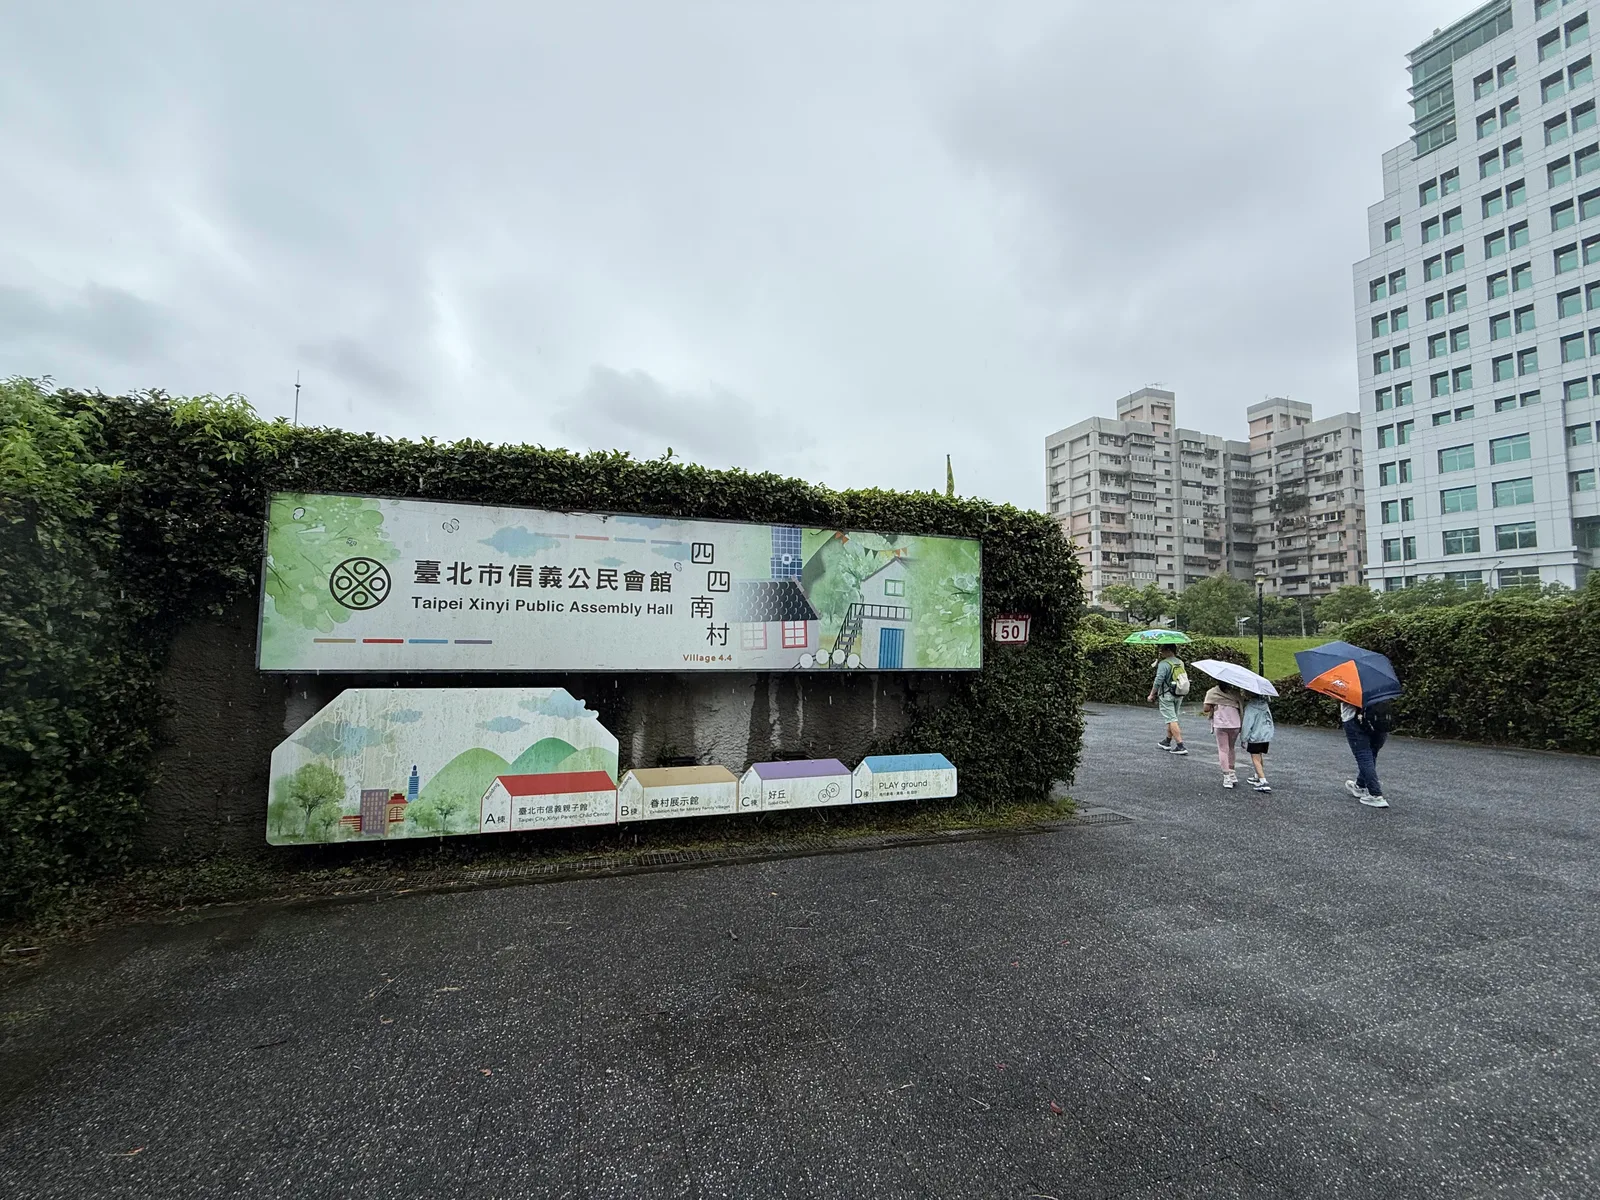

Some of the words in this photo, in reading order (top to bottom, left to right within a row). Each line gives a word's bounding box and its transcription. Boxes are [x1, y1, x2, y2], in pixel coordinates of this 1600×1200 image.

[414, 559, 672, 593] 臺北市信義公民會館
[690, 542, 730, 646] 四四南村
[411, 596, 463, 612] Taipei
[469, 598, 510, 614] Xinyi
[515, 599, 564, 613] Public
[570, 601, 642, 617] Assembly
[647, 603, 673, 615] Hall
[1001, 625, 1020, 639] 50
[683, 654, 716, 663] Village
[718, 654, 732, 662] 4.4
[485, 782, 500, 800] Building
[879, 782, 900, 790] PLAY
[900, 779, 928, 790] ground
[768, 789, 786, 800] 好丘
[650, 796, 699, 808] 眷村展示館
[518, 803, 588, 815] 臺北市信義親子館
